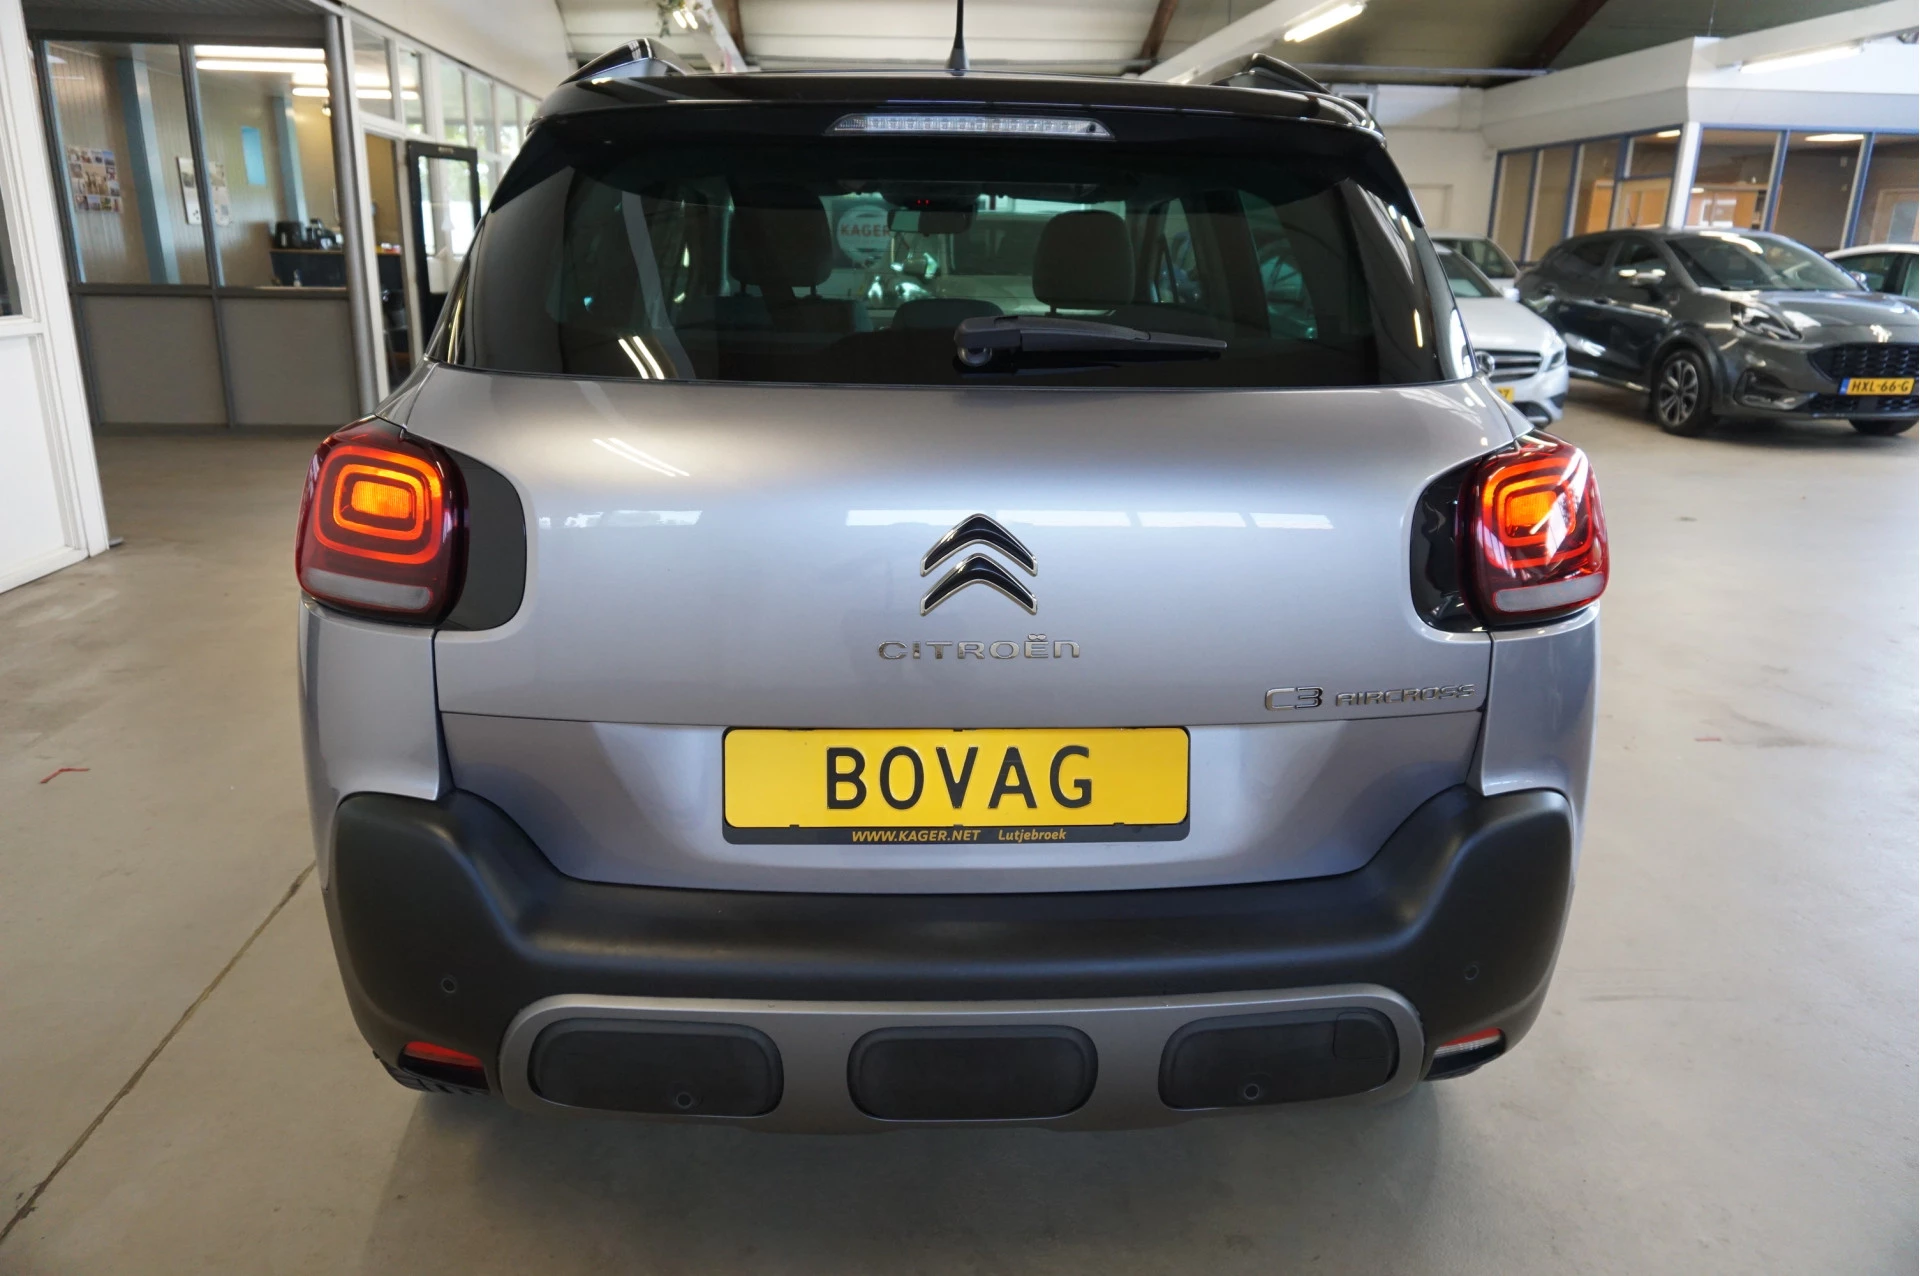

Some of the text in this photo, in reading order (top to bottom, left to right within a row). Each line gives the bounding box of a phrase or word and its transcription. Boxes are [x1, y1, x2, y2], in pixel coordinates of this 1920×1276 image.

[840, 223, 890, 237] KAGER
[1851, 381, 1910, 392] HXL-66-G
[1265, 684, 1475, 711] C3 AIRCROSS
[826, 744, 1093, 810] BOVAG
[852, 828, 1066, 844] WWW.KAGER.NET Lutjebroek
